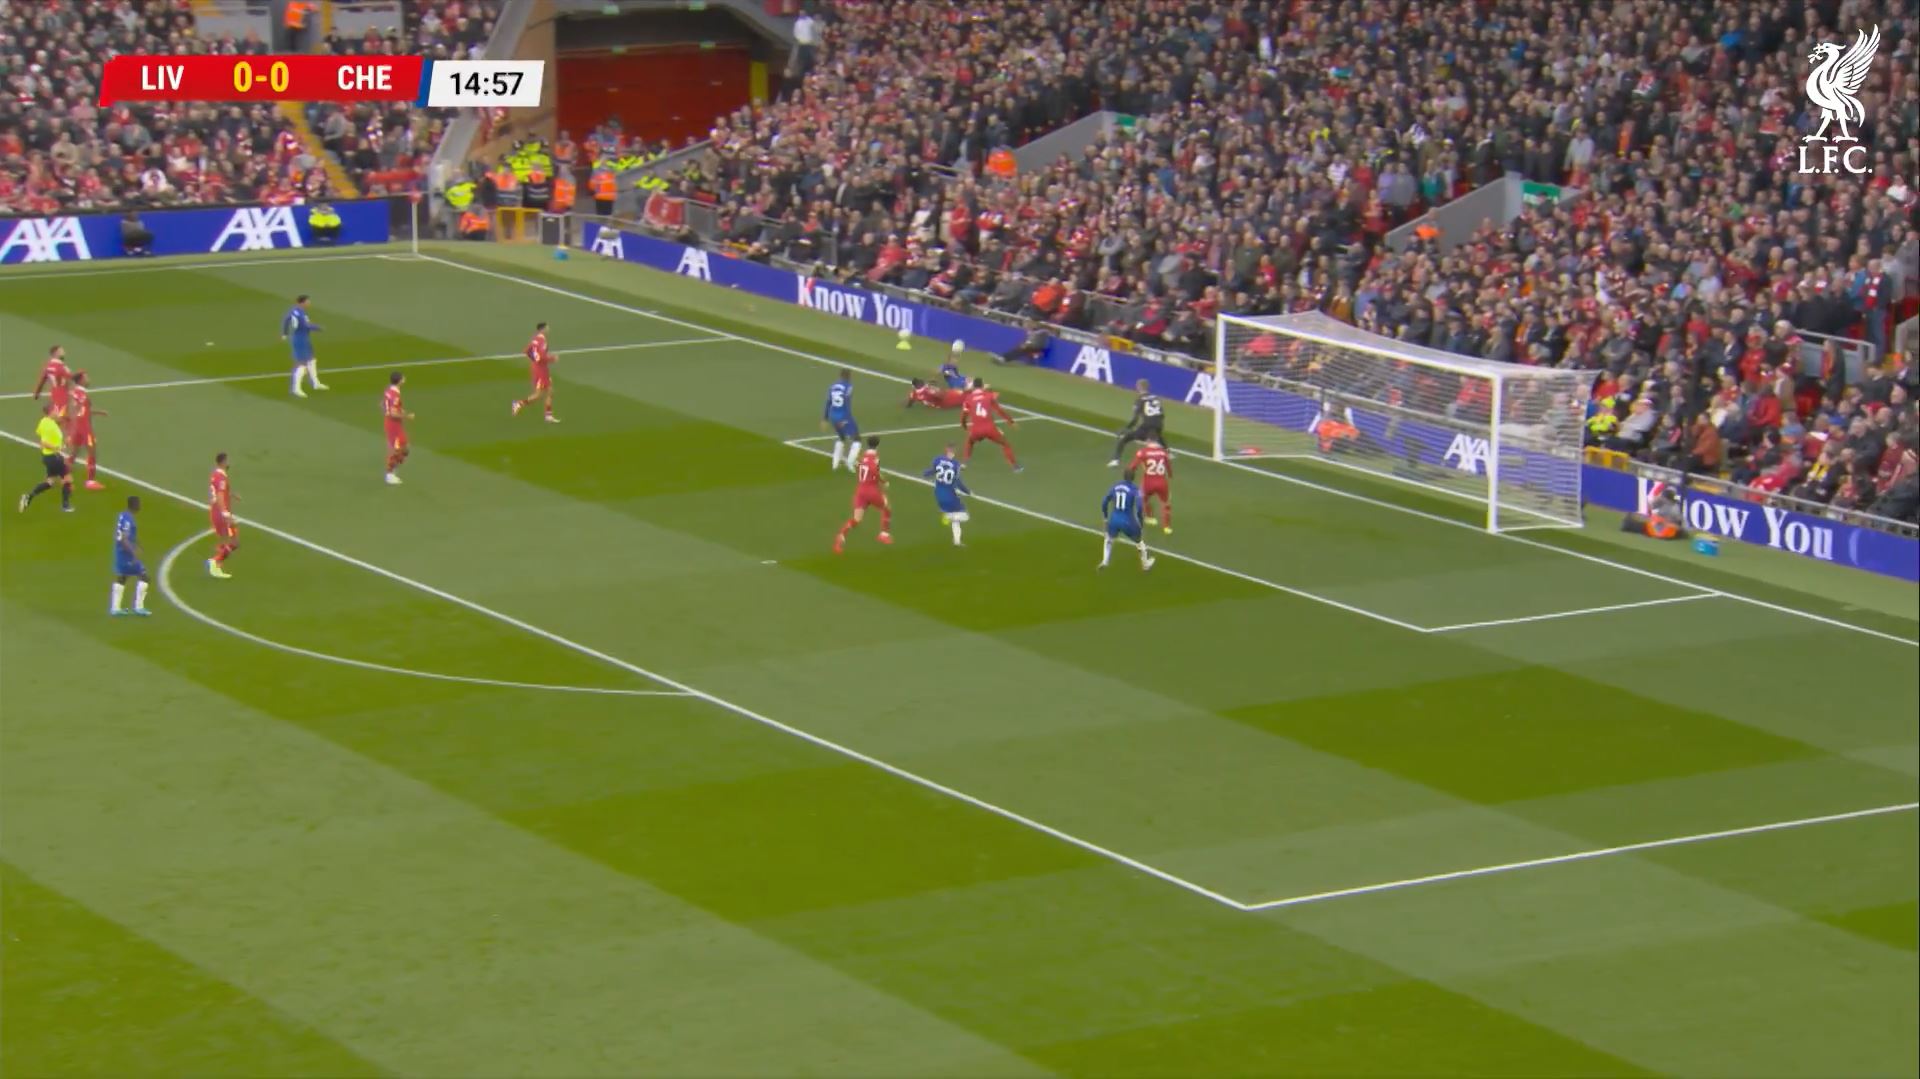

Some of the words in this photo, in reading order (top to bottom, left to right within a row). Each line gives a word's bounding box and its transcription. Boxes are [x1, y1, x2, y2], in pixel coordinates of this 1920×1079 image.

[0, 215, 93, 264] AXA
[210, 206, 303, 252] AXA
[676, 246, 712, 282] AXA
[797, 274, 866, 320] Know
[1070, 344, 1113, 385] AXA
[975, 402, 988, 418] 4
[935, 465, 956, 485] 20
[1146, 458, 1166, 476] 26
[1443, 433, 1493, 476] AXA
[1115, 491, 1127, 511] 11
[1762, 505, 1834, 562] You
